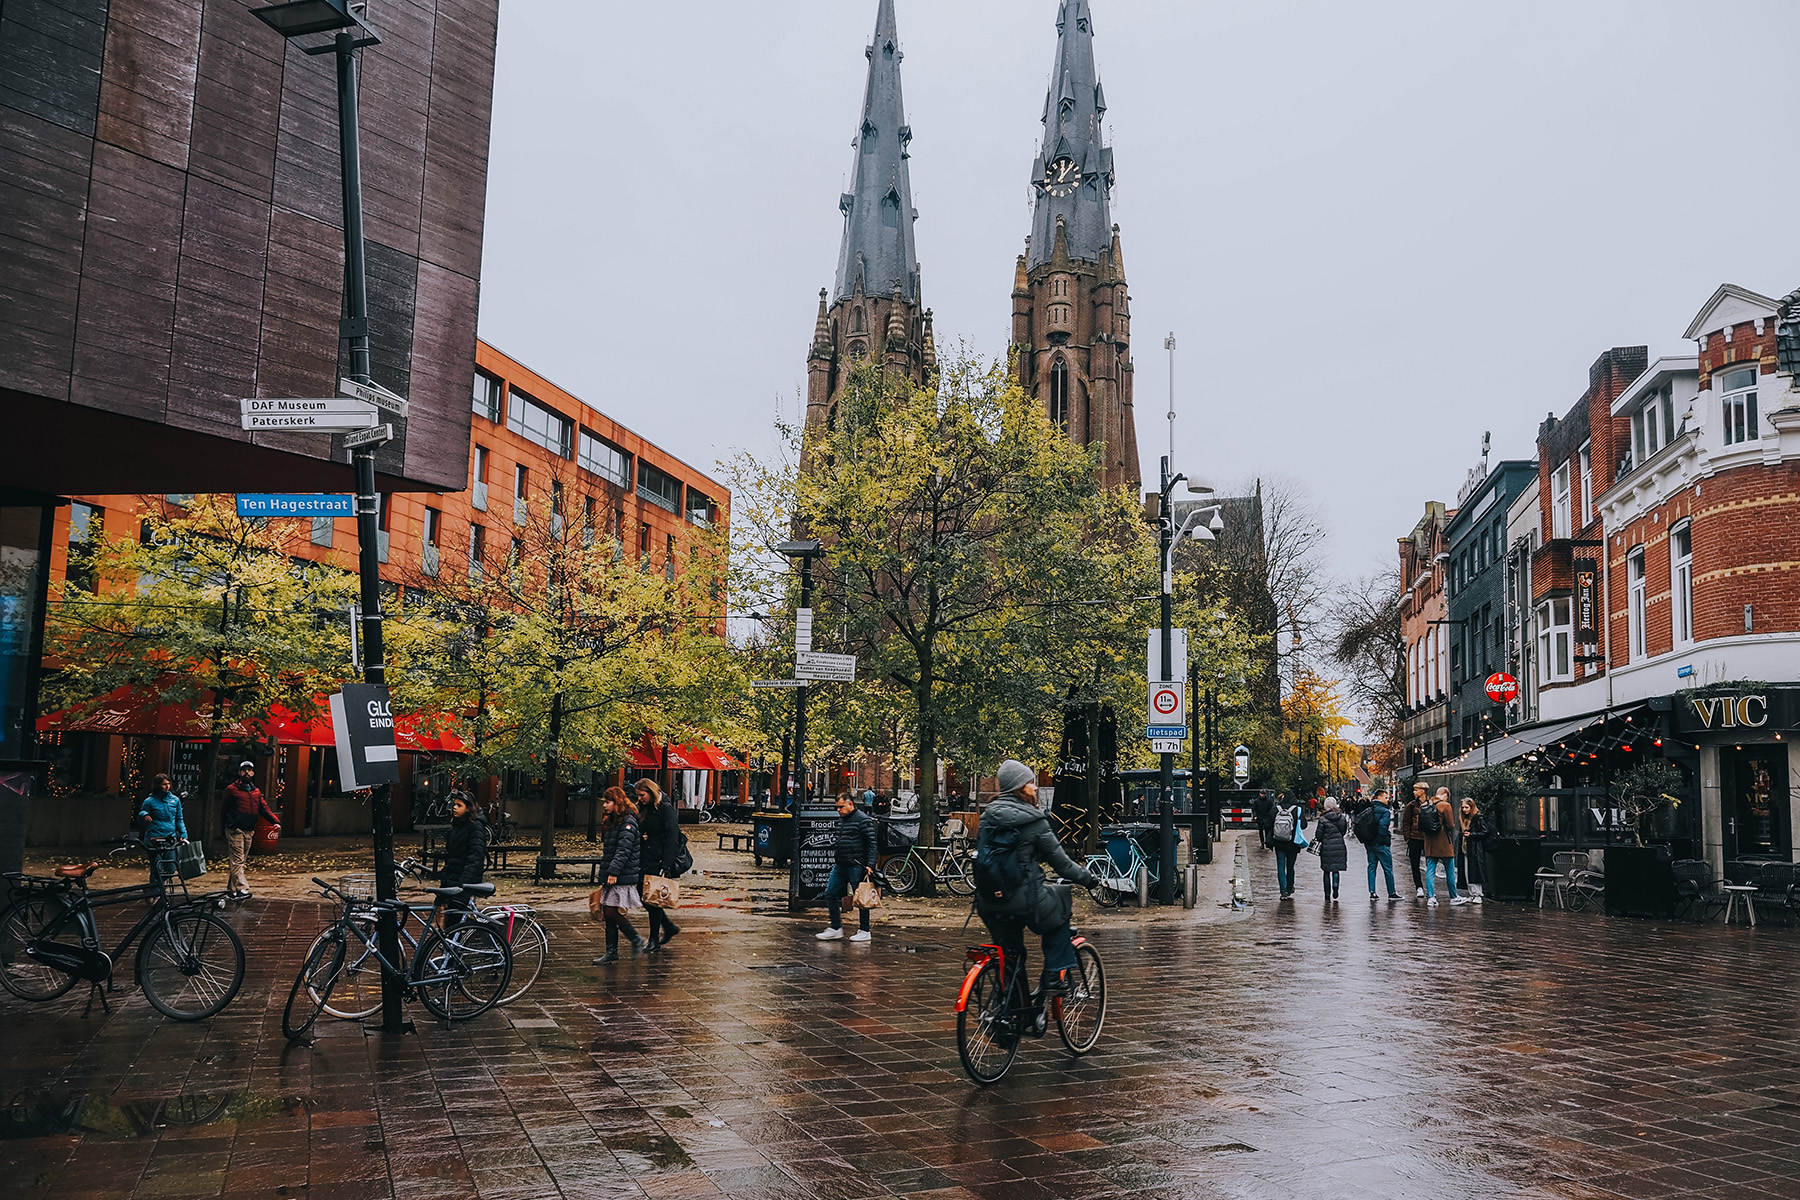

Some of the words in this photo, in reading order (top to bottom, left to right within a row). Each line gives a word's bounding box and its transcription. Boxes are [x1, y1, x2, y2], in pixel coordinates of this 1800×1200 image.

[251, 400, 275, 410] DAF
[278, 400, 327, 410] Museum
[375, 396, 401, 412] museum
[252, 416, 316, 426] Paterskerk
[359, 431, 371, 442] Expat
[371, 427, 386, 439] Center
[241, 498, 266, 510] Ten
[270, 499, 349, 512] Hagestraat
[1580, 588, 1592, 603] Jan
[1581, 603, 1593, 630] Hertog
[1486, 682, 1516, 693] Coca-Cola
[1691, 695, 1768, 728] VIC
[369, 718, 393, 728] EIND
[1149, 728, 1183, 737] fietspad
[180, 742, 204, 751] THINK
